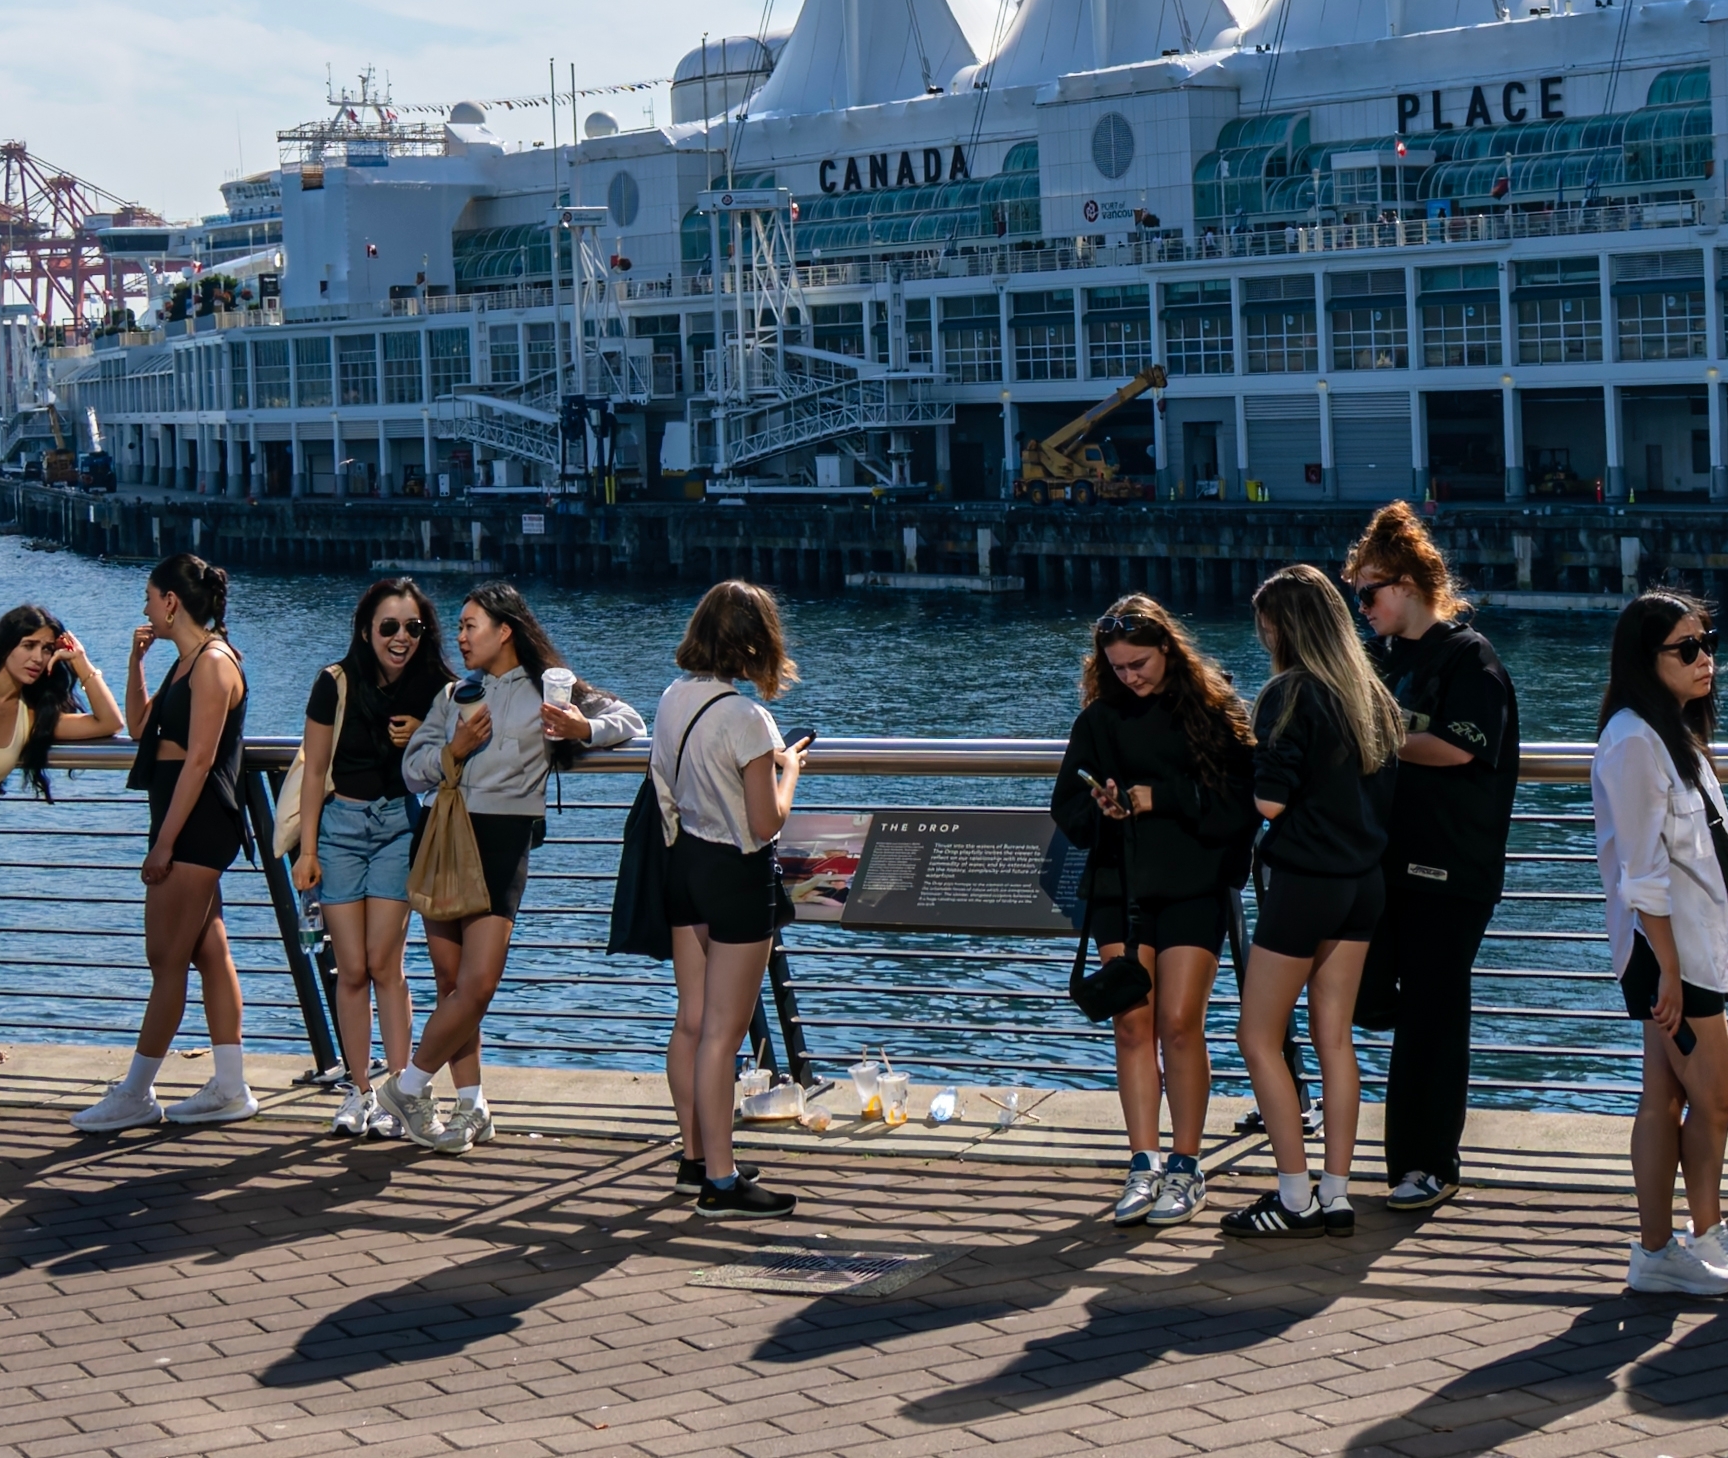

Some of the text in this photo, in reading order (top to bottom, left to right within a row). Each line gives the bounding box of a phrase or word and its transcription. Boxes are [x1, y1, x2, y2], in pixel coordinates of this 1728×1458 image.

[1397, 76, 1564, 133] PLACE
[819, 144, 970, 193] CANADA
[1100, 200, 1126, 210] PORT of
[1101, 209, 1134, 219] vancou
[881, 823, 960, 832] THE DROP
